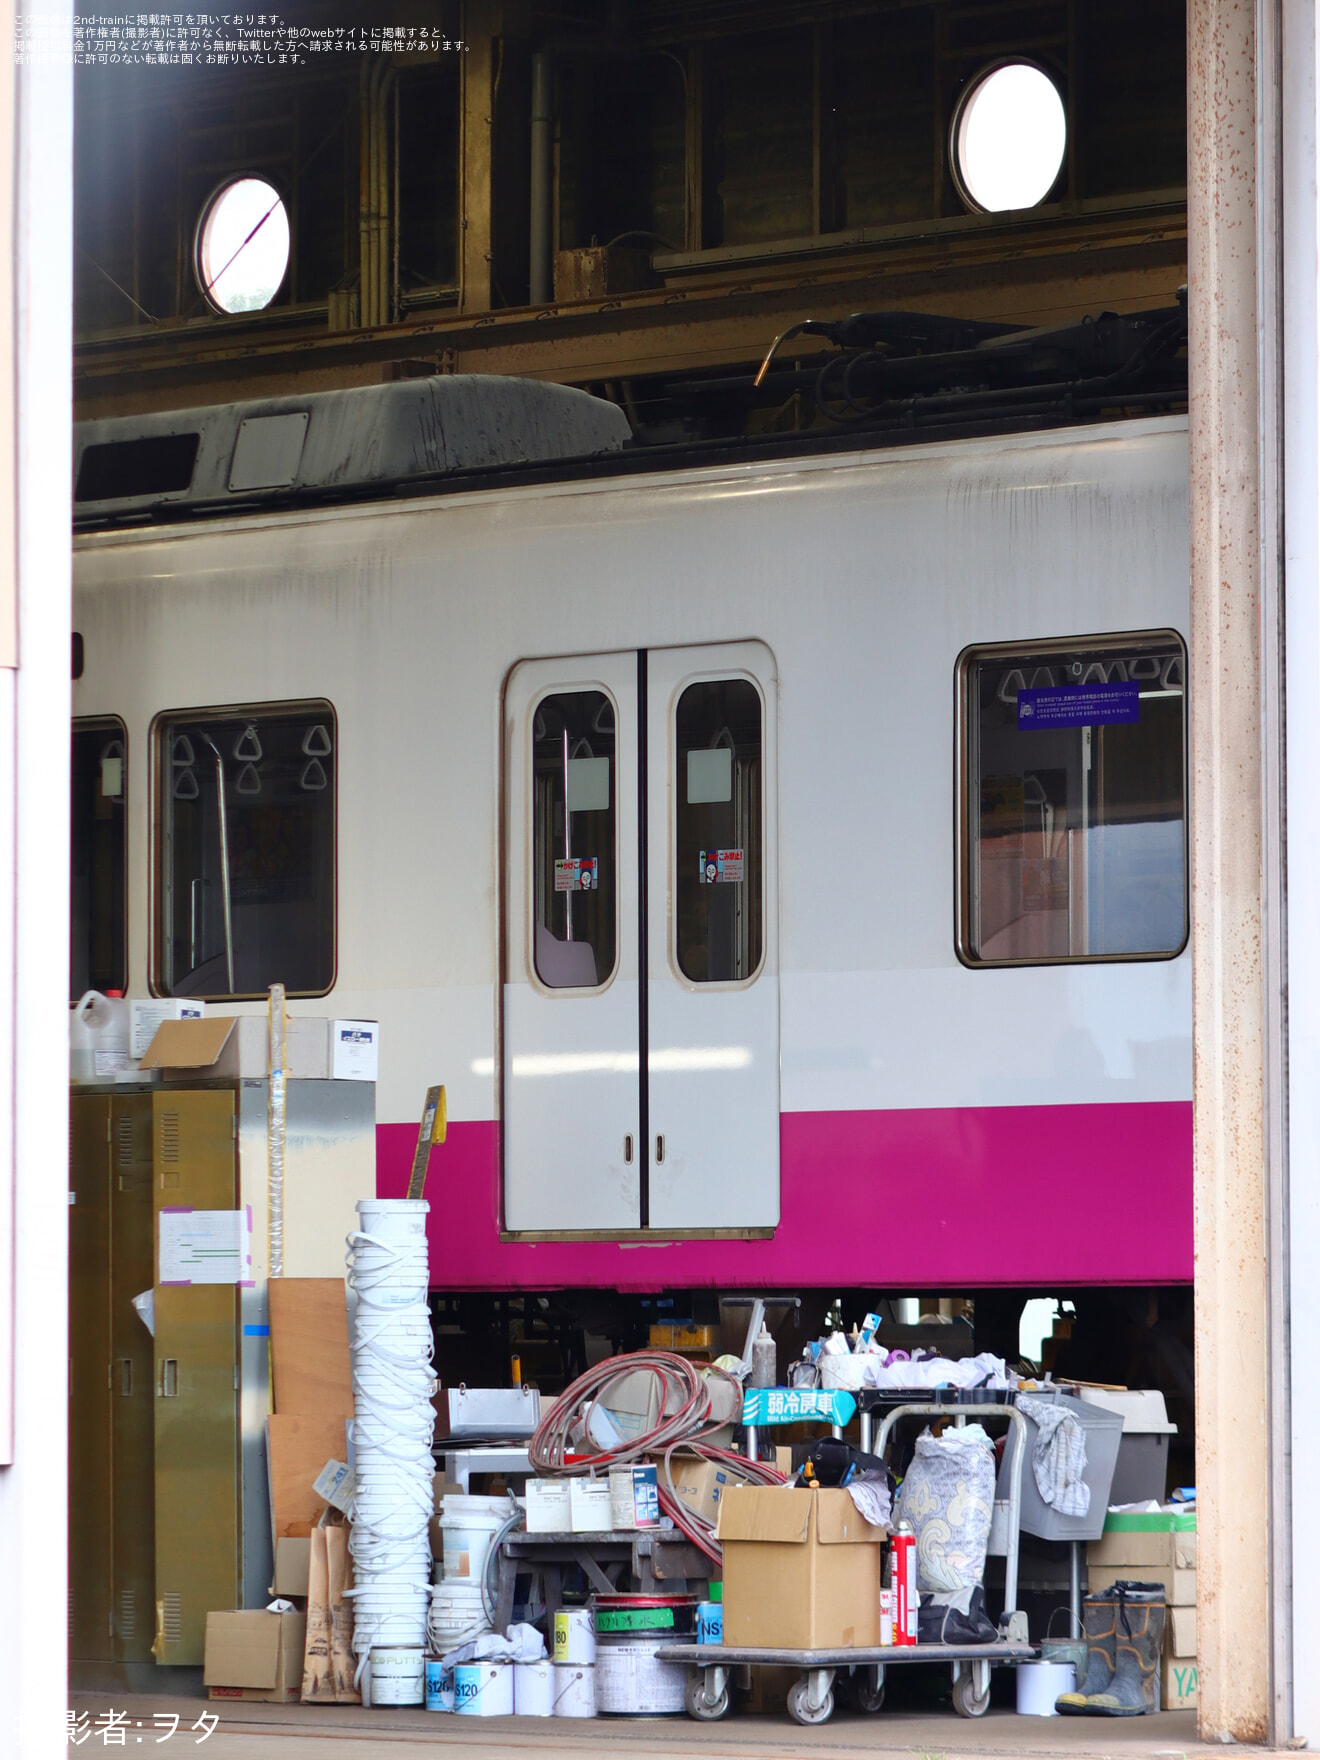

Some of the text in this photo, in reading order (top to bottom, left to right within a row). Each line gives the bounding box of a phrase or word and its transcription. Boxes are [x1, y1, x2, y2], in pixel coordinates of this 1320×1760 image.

[768, 1391, 833, 1415] 弱冷房車
[701, 1622, 722, 1636] NS
